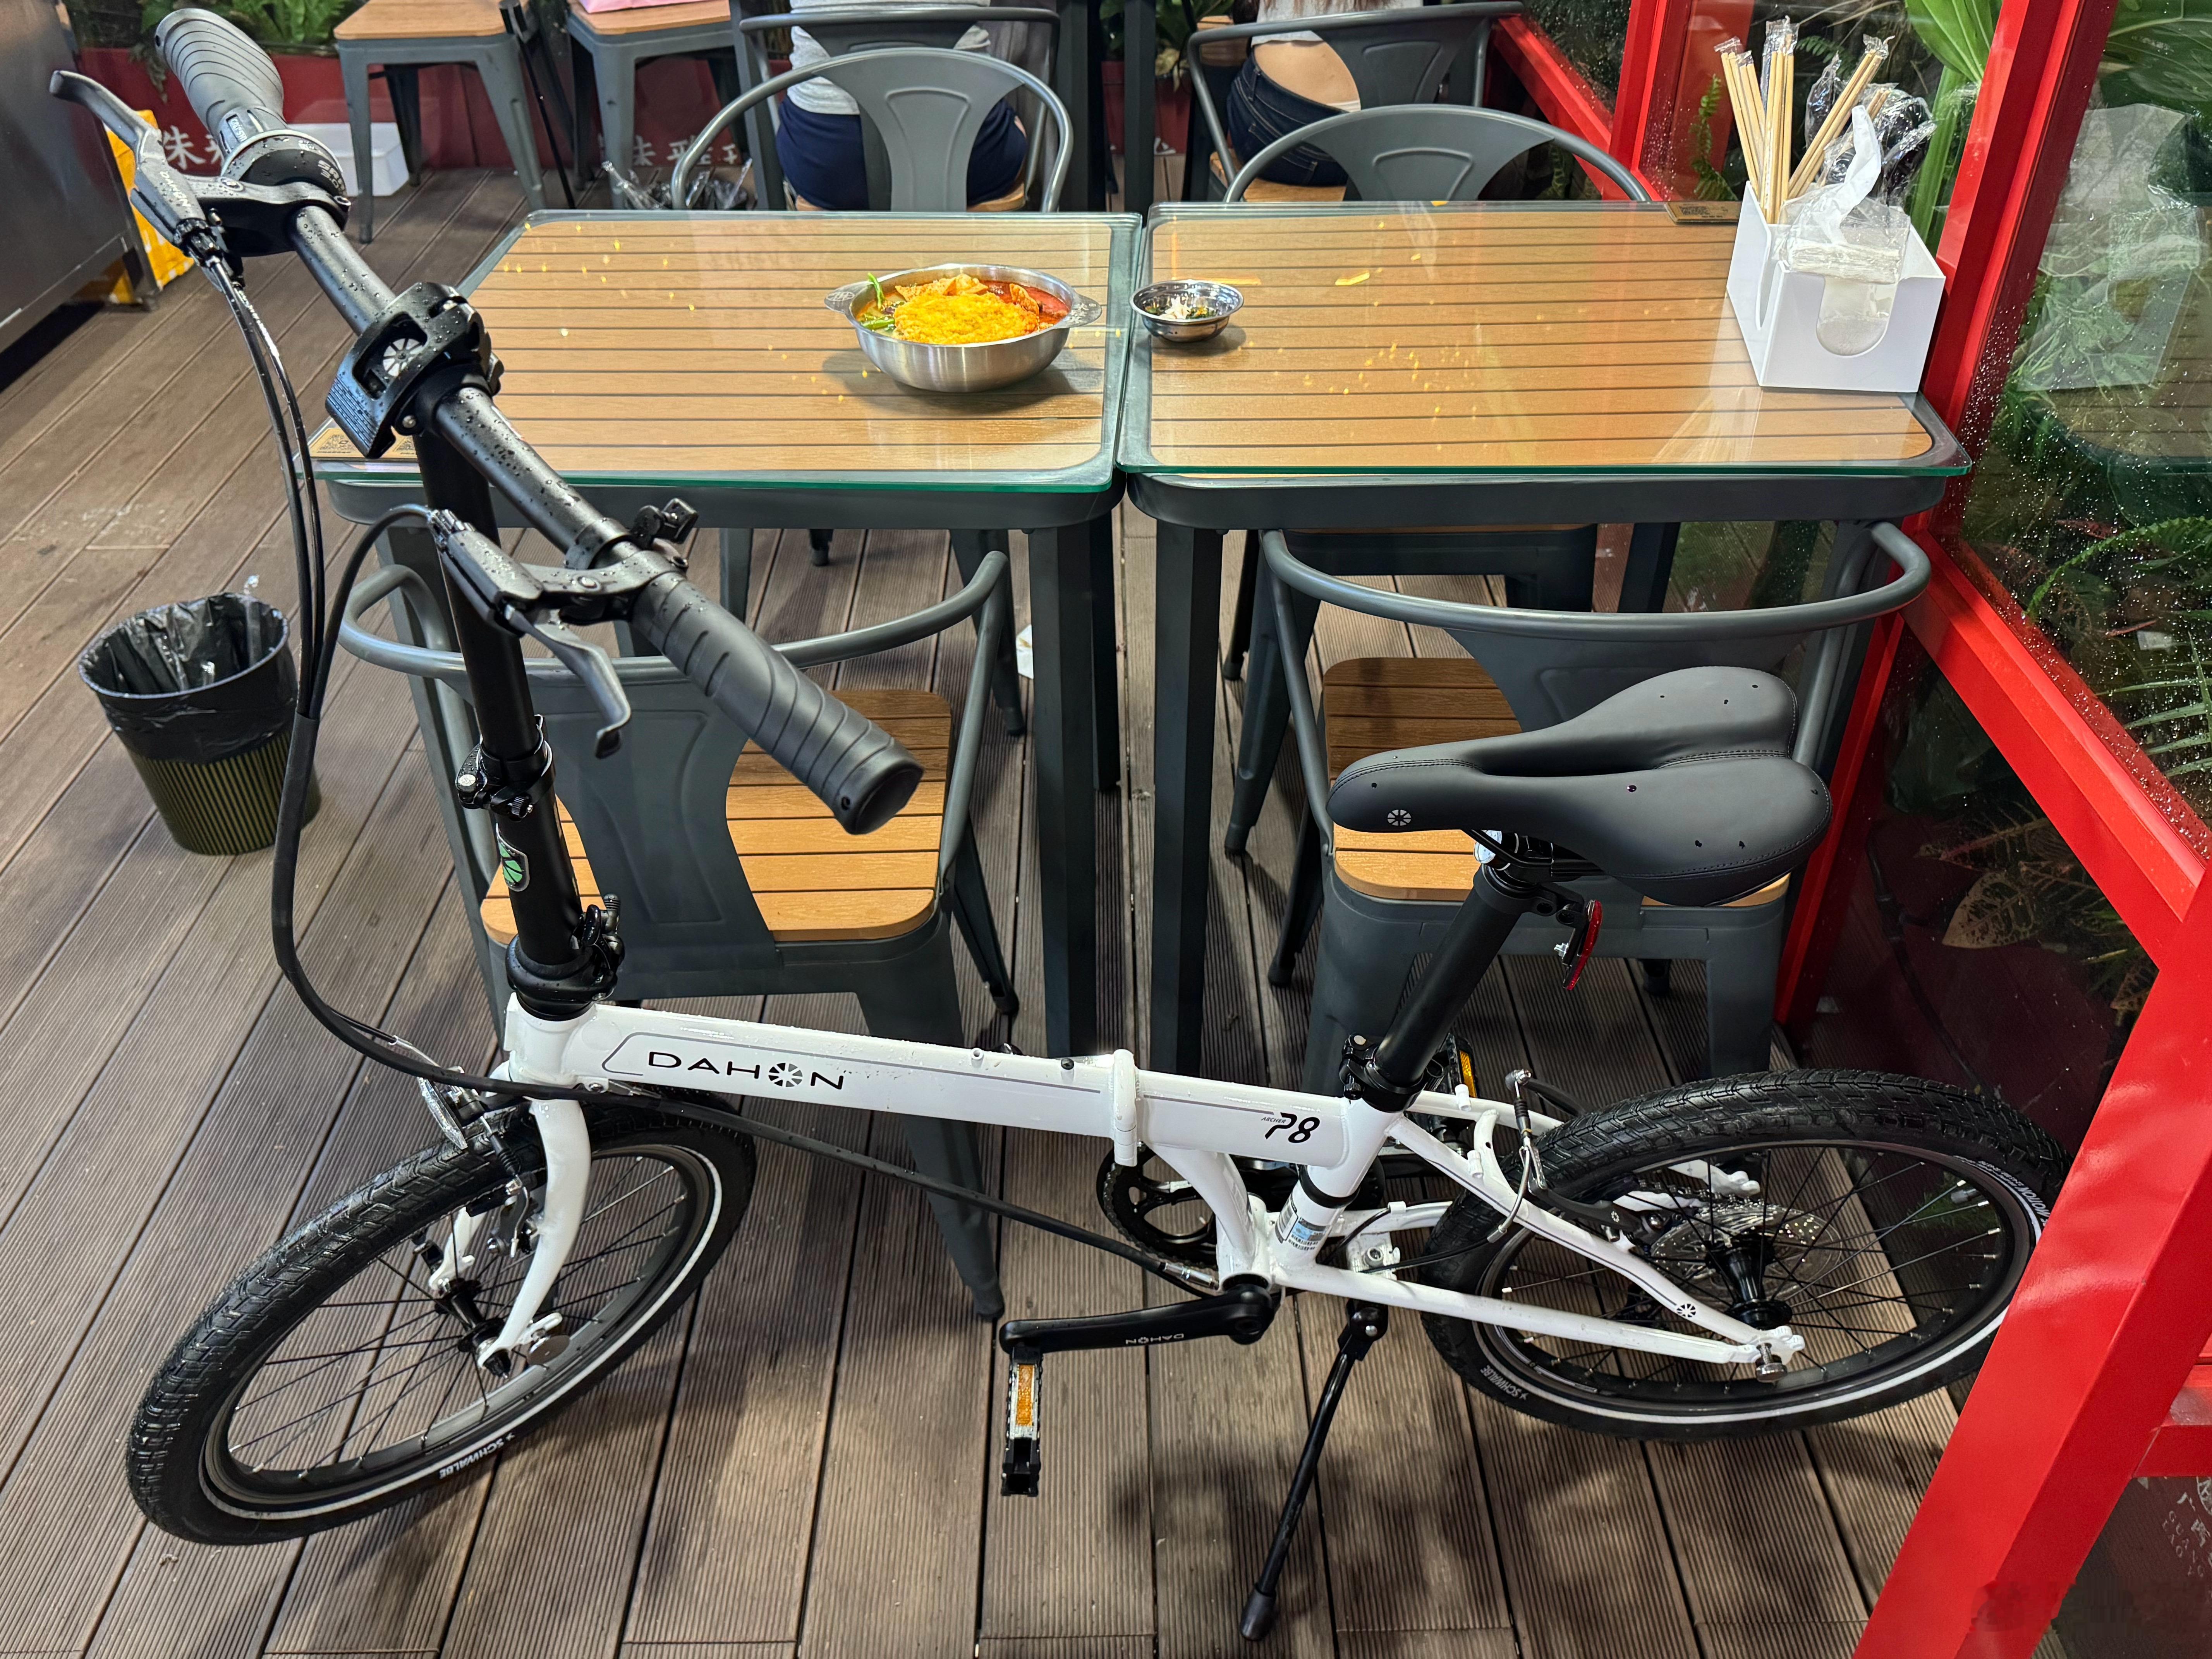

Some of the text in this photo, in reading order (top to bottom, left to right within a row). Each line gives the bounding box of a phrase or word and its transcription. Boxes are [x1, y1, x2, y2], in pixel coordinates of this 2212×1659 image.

[649, 1051, 844, 1090] DAHON
[1265, 1112, 1320, 1143] P8
[1125, 1333, 1184, 1345] DAHON
[1480, 1365, 1522, 1397] SCHWALBE
[439, 1438, 505, 1479] SCHWALBE
